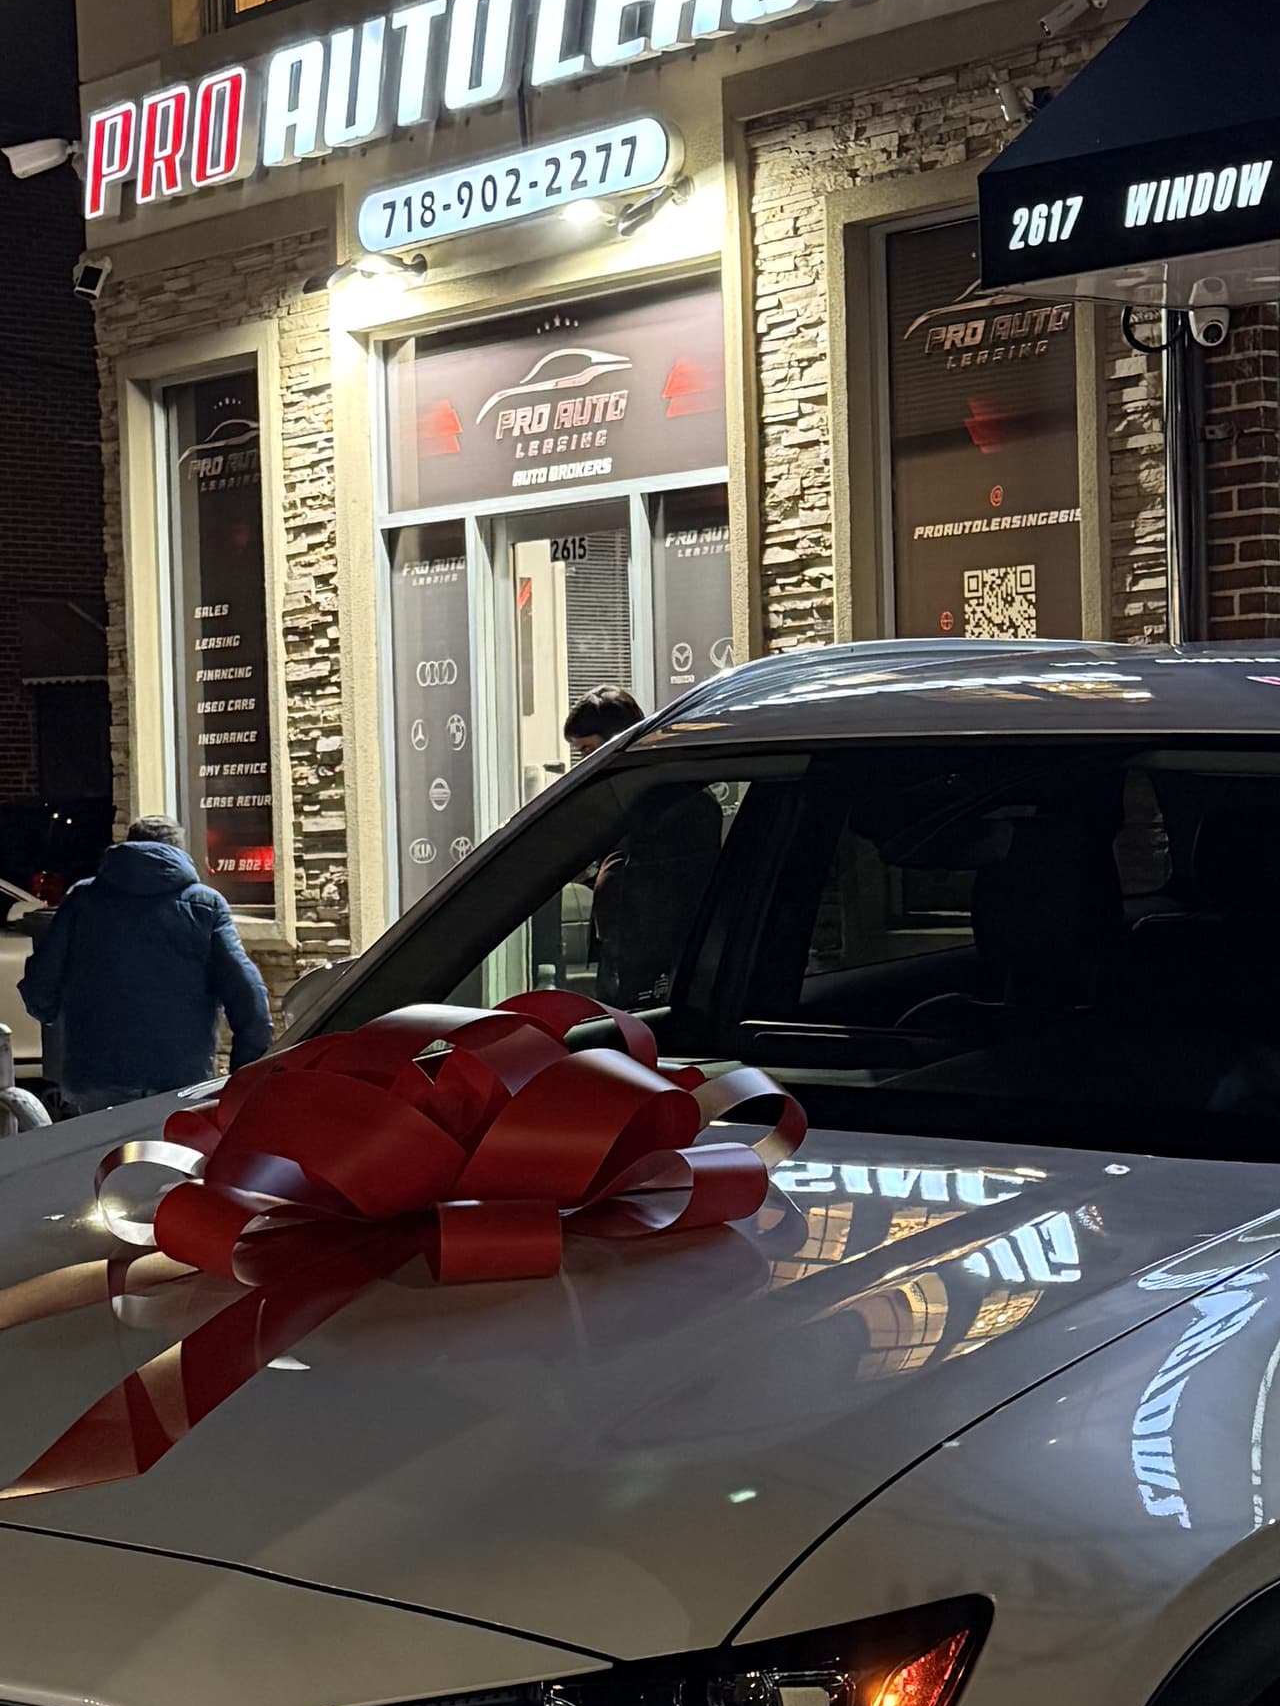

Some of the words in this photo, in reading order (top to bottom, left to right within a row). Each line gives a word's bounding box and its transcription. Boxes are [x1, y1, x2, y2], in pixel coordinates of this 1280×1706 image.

[85, 64, 248, 221] PRO
[381, 135, 638, 239] 718-902-2277
[1123, 159, 1272, 229] WINDOW
[1008, 195, 1085, 251] 2617
[924, 317, 987, 354] PRO
[990, 303, 1073, 342] AUTO
[946, 339, 1050, 371] LEASING
[496, 406, 552, 441] PRO
[553, 388, 630, 432] AUTO
[514, 429, 609, 459] LEASING
[510, 467, 548, 488] AUTO
[548, 456, 614, 484] BROKERS
[550, 537, 588, 563] 2615
[194, 604, 230, 619] SALES
[195, 634, 241, 651] LEASING
[196, 665, 254, 682] FINANCING
[197, 699, 226, 714] USED
[227, 697, 256, 712] CARS
[198, 730, 258, 746] INSURANCE
[222, 761, 268, 777] SERVICE
[200, 795, 235, 810] LEASE
[236, 792, 274, 809] RETUR
[216, 858, 235, 873] 718
[238, 857, 262, 872] 902
